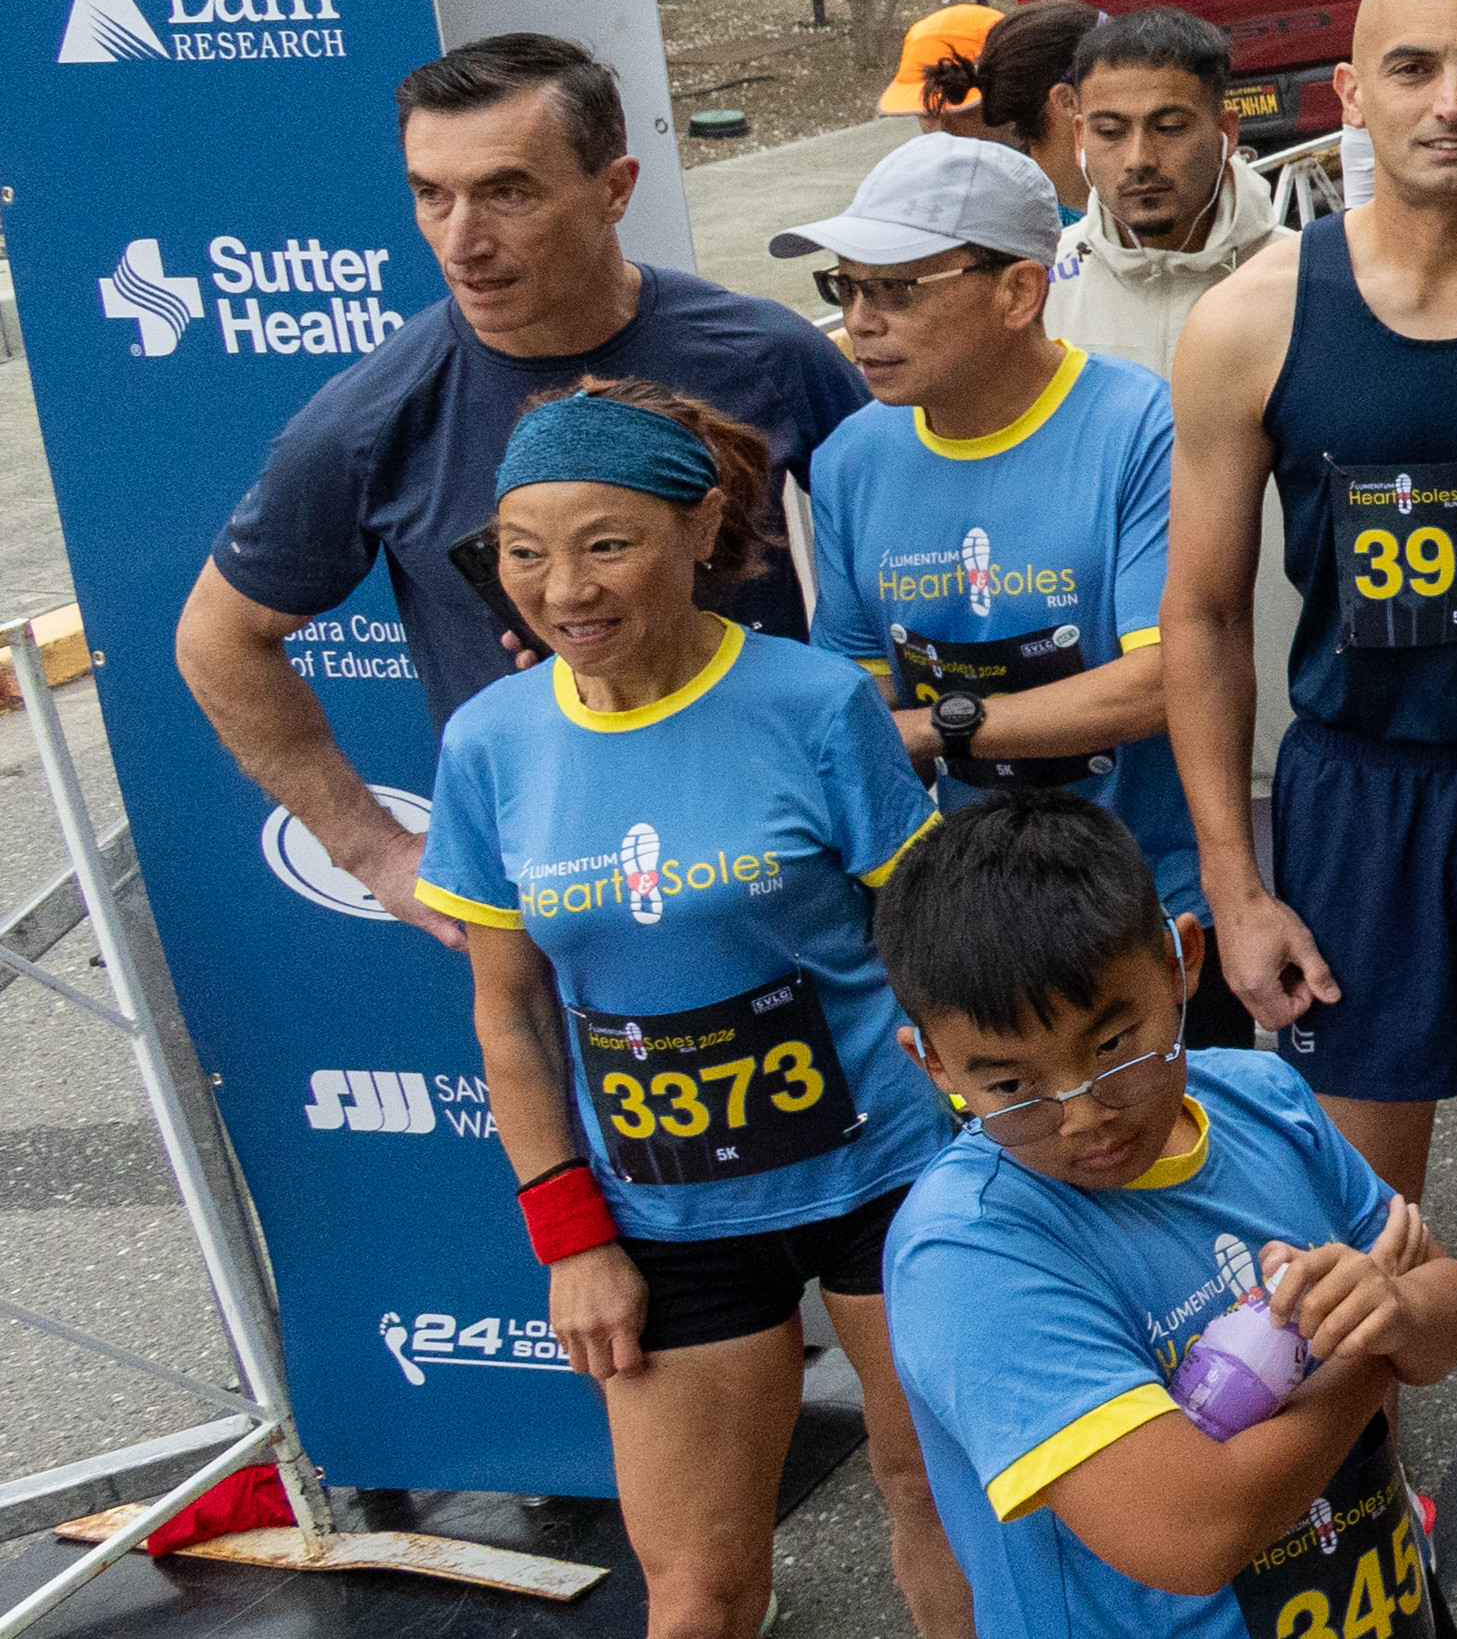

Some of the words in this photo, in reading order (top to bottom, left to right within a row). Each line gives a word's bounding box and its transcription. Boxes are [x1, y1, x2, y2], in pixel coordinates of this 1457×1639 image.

[172, 29, 347, 61] RESEARCH
[209, 236, 390, 292] Sutter
[217, 298, 405, 354] Health
[1349, 489, 1397, 506] Heart
[888, 550, 960, 568] LUMENTUM
[879, 566, 965, 602] Heart
[990, 563, 1075, 596] Soles
[1047, 594, 1079, 609] RUN
[528, 852, 618, 880] LUMENTUM
[519, 867, 623, 918] Heart
[661, 850, 781, 895] Soles
[749, 876, 784, 897] RUN
[755, 988, 788, 1009] SVLG
[643, 1034, 694, 1051] Soles
[699, 1028, 736, 1050] 2026
[602, 1040, 825, 1140] 3373
[716, 1146, 740, 1162] 5K
[412, 1312, 504, 1356] 24
[1252, 1528, 1317, 1575] Heart
[1334, 1488, 1385, 1534] Soles
